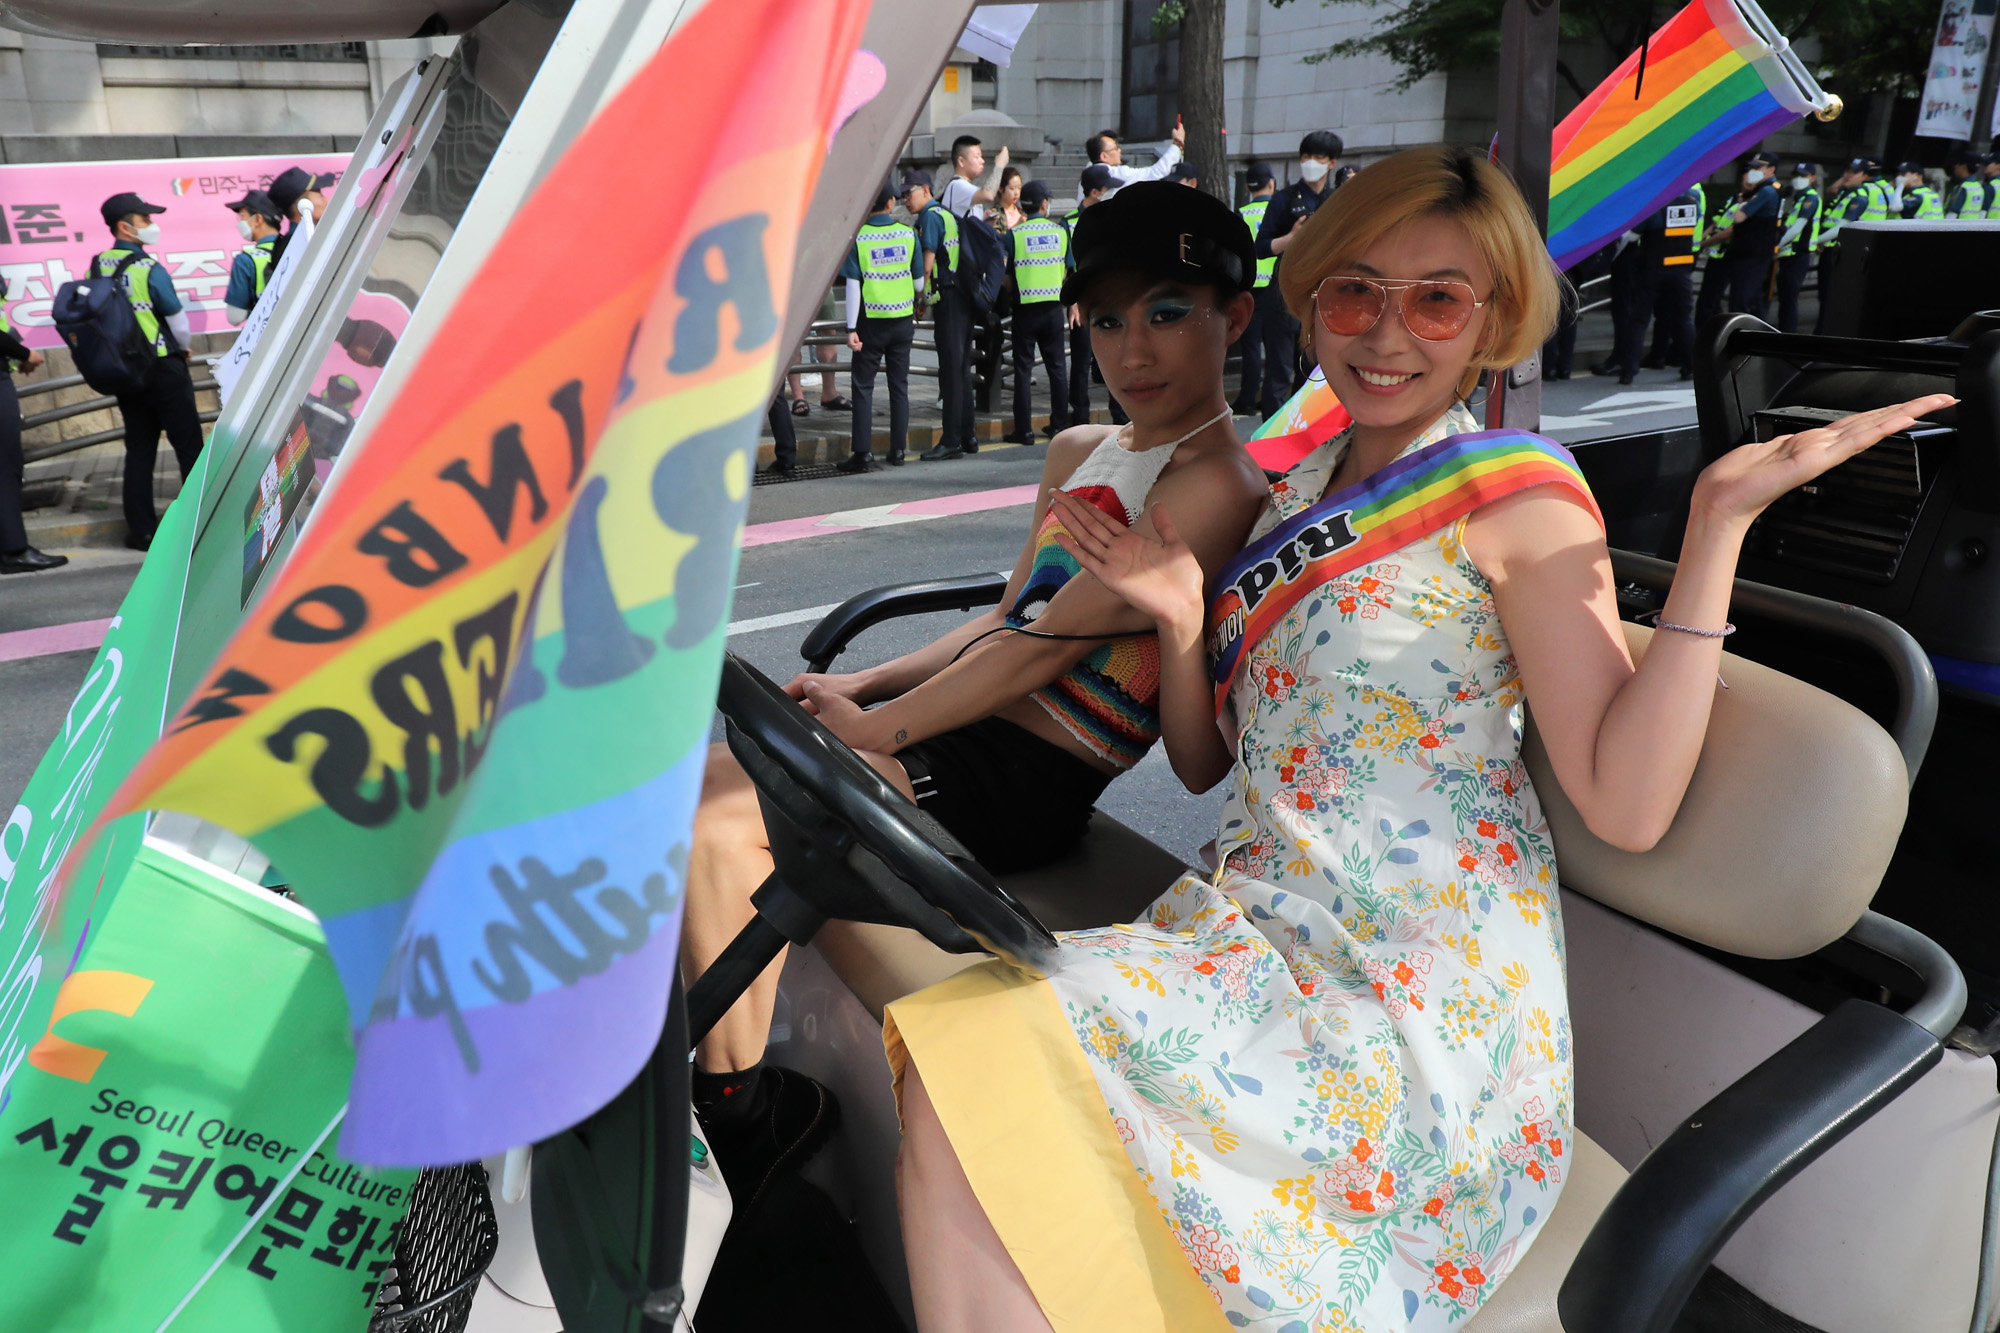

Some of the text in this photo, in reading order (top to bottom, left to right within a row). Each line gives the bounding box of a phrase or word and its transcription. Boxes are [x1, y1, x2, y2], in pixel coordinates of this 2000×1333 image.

[1223, 511, 1358, 612] Rid
[90, 1088, 194, 1138] Seoul
[196, 1118, 298, 1164] Queer
[300, 1151, 402, 1207] Culture
